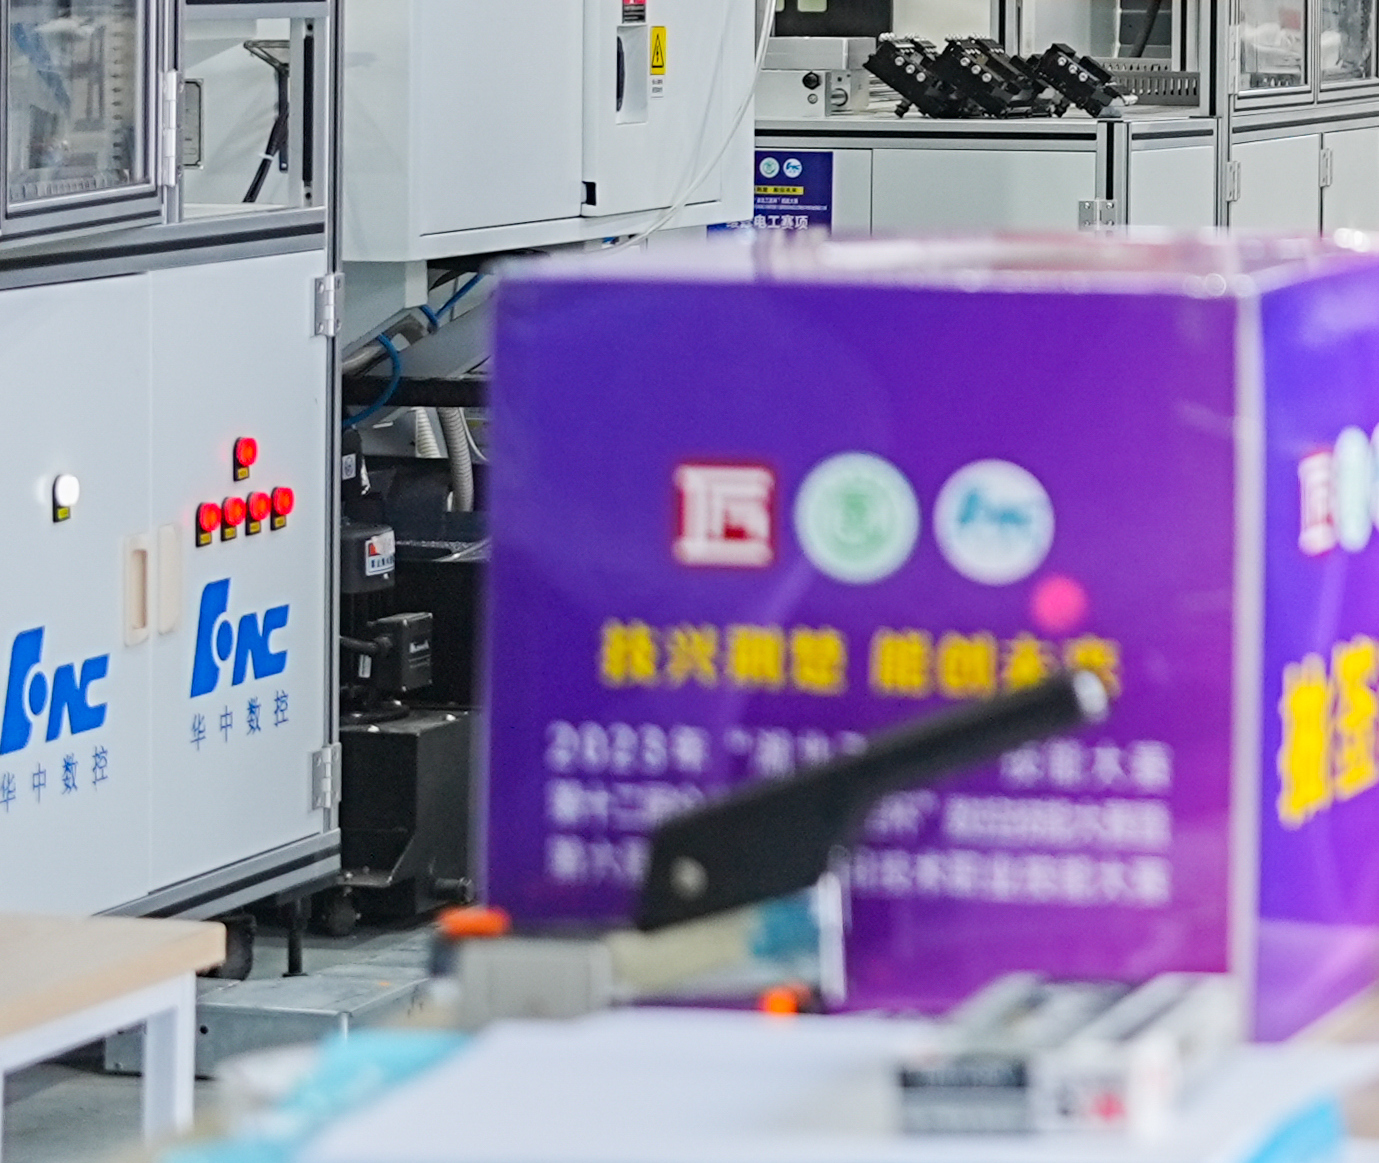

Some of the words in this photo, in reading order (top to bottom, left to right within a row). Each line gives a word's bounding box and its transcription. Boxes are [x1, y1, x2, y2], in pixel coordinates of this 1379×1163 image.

[189, 690, 290, 751] 华中数控
[0, 745, 109, 813] 华中数控
